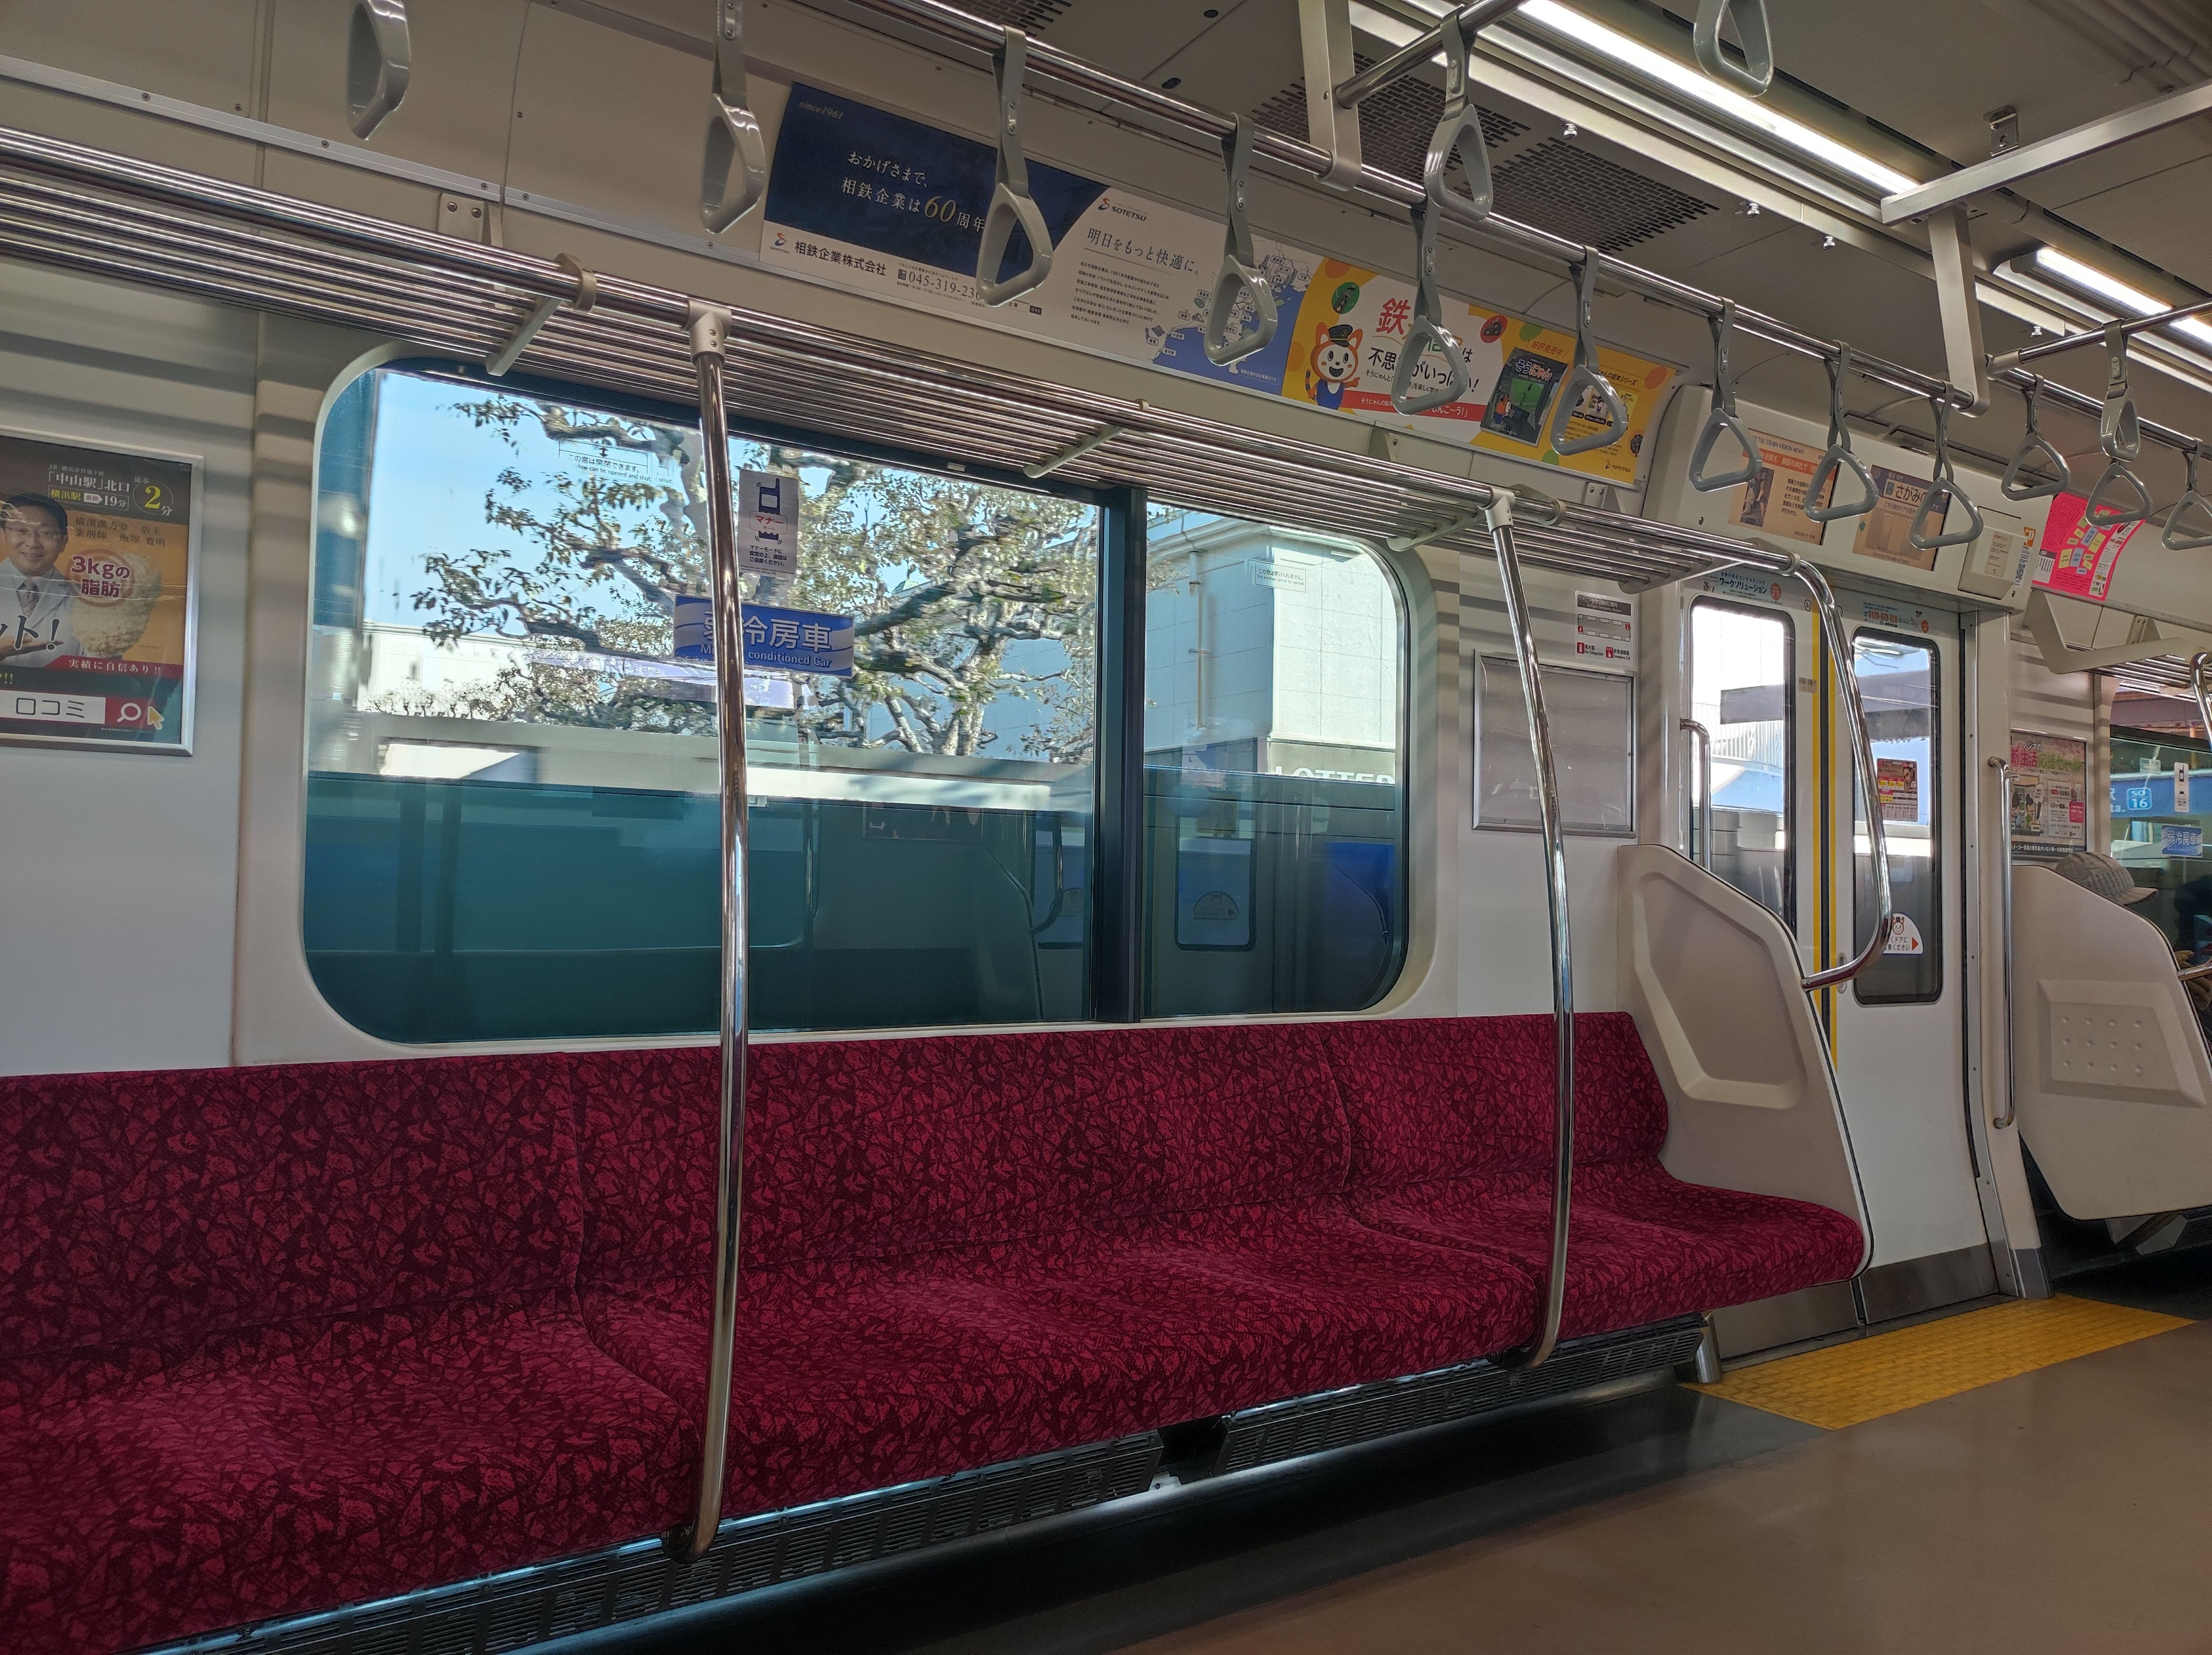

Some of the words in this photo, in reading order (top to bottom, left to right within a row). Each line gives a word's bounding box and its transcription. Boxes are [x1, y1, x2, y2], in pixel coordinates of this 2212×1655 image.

[799, 101, 844, 120] since1961
[848, 152, 928, 188] おかげさまで、
[842, 178, 985, 232] 相鉄企業は60周年
[1111, 206, 1147, 221] SOTETSU
[795, 241, 886, 276] 相鉄企業株式会社
[1087, 228, 1198, 276] 明日をもっと快適に。
[909, 271, 982, 300] 045-319-23
[1516, 359, 1553, 381] そうにゃん
[1766, 439, 1779, 448] TRAIN
[1779, 442, 1792, 451] VISION
[569, 454, 639, 473] この窓は開閉できます。
[1612, 464, 1630, 472] SOTETSU
[49, 471, 130, 492] 「中山駅」北口
[51, 489, 81, 501] 横浜駅
[103, 495, 126, 507] 19分
[144, 486, 161, 509] 2
[756, 515, 783, 524] マナー
[749, 551, 787, 560] 設定の上、通話は
[750, 545, 783, 554] マナーモードに
[72, 555, 131, 579] 3kgの
[749, 557, 785, 566] ご遠慮ください。
[81, 579, 120, 596] 脂肪
[1719, 578, 1767, 594] ワークソリューション
[69, 659, 160, 674] 実績に自信あり!!
[748, 652, 810, 665] conditioned
[814, 656, 831, 667] Car
[2023, 741, 2042, 752] ノジマの
[2011, 746, 2081, 771] 新生活応援セール
[2132, 799, 2148, 808] 16
[2168, 830, 2197, 846] 弱冷房車
